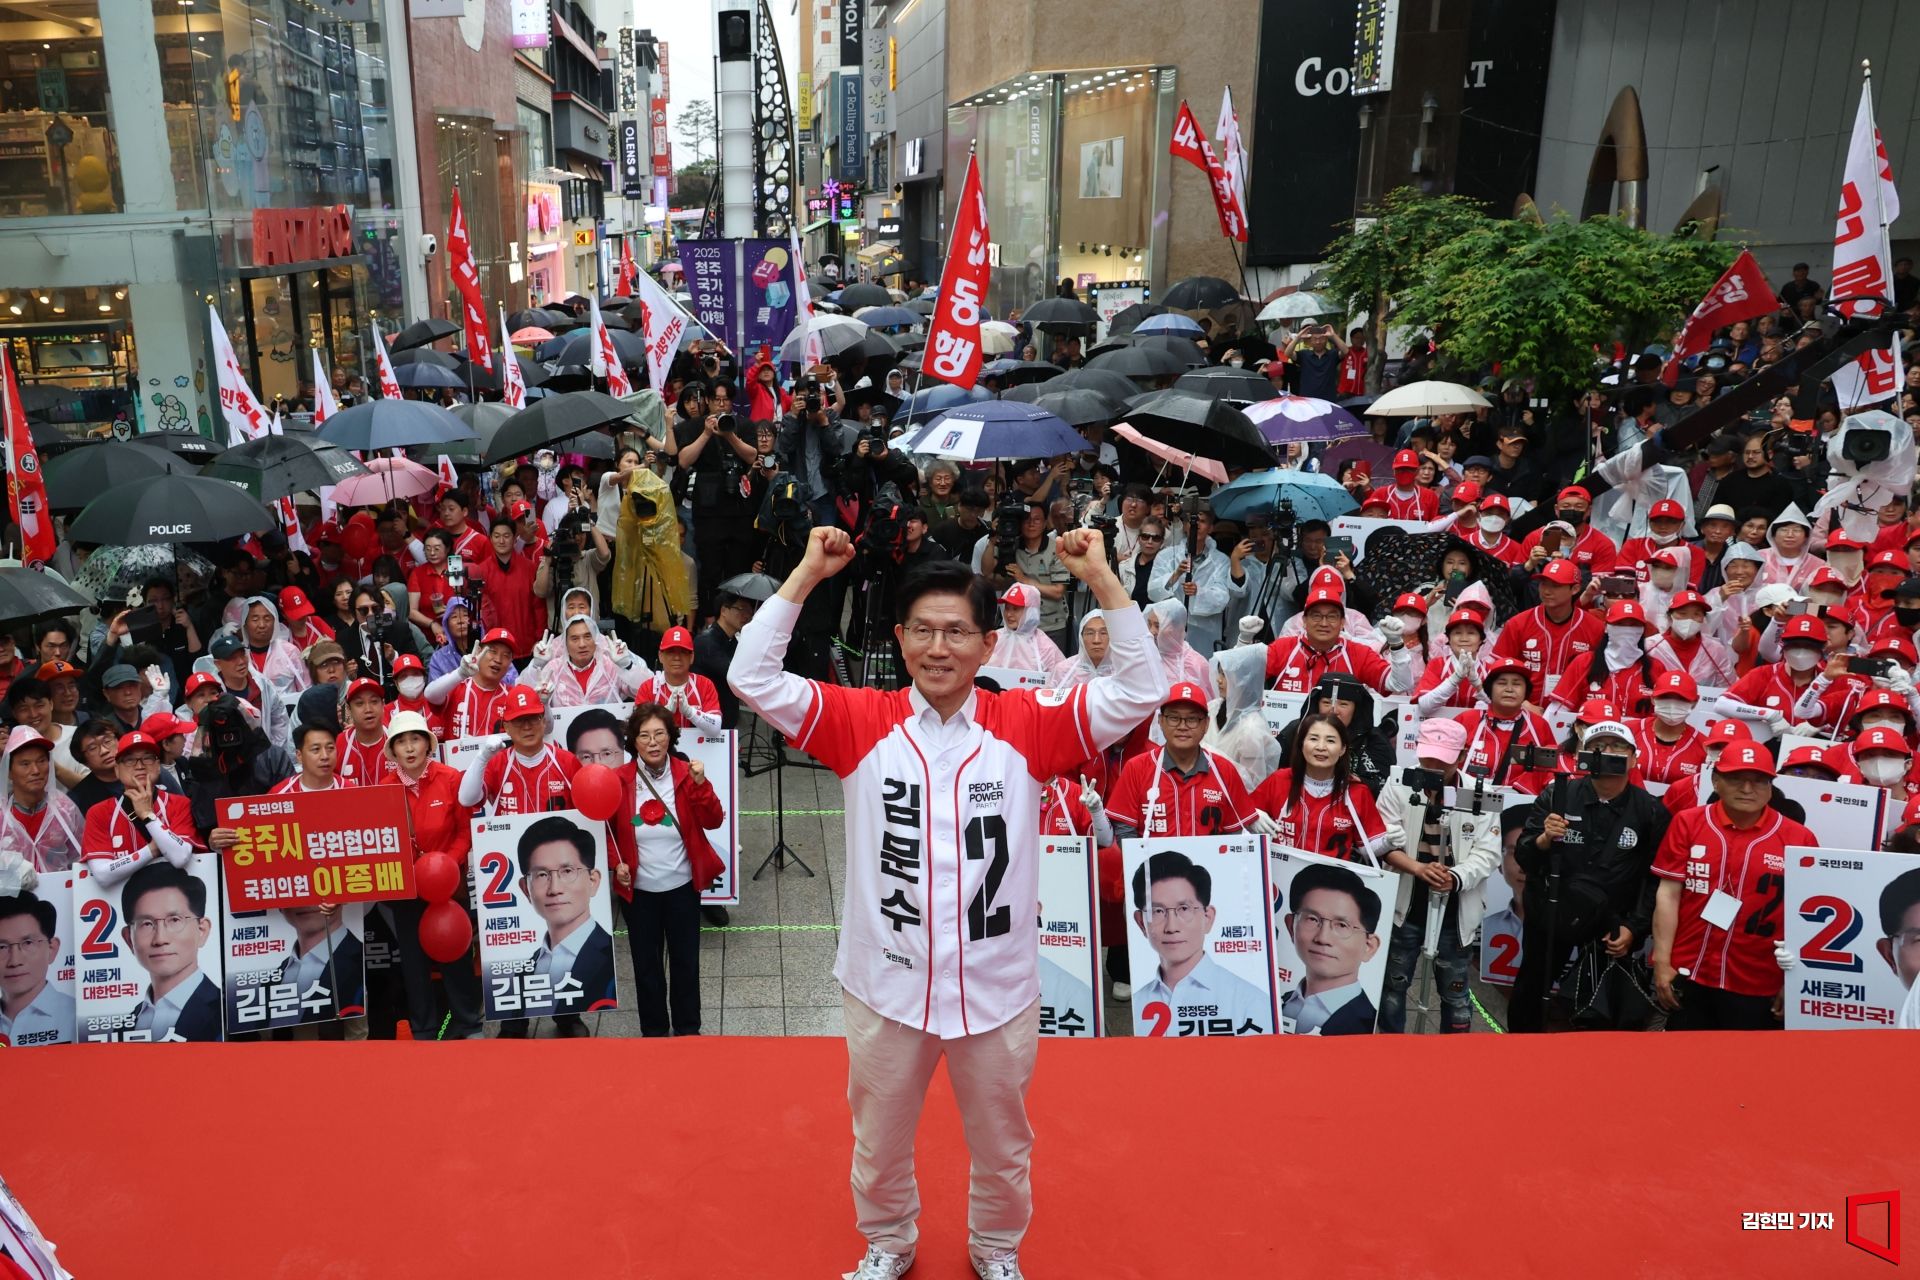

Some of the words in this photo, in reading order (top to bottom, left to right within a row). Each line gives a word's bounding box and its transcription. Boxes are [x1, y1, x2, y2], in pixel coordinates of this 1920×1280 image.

[524, 35, 538, 46] 3F
[1464, 60, 1493, 88] T
[845, 97, 857, 132] Rolling
[625, 126, 636, 166] OLENS
[847, 135, 857, 163] Pasta
[694, 248, 721, 258] 2025
[695, 261, 722, 276] 청주
[754, 263, 774, 278] 신
[697, 277, 723, 292] 국가
[699, 294, 724, 309] 유산
[700, 311, 725, 326] 야행
[1402, 454, 1409, 462] 2
[334, 461, 358, 474] POLICE
[1661, 503, 1669, 511] 2
[149, 524, 192, 535] POLICE
[1884, 552, 1893, 561] 2
[1550, 563, 1560, 573] 2
[1324, 573, 1332, 582] 2
[1010, 588, 1018, 597] 2
[1319, 590, 1327, 599] 2
[1688, 592, 1696, 601] 2
[293, 595, 301, 605] 2
[1407, 596, 1415, 605] 2
[1624, 603, 1633, 613] 2
[1461, 612, 1469, 620] 2
[1800, 620, 1810, 632] 2
[673, 631, 681, 641] 2
[1889, 639, 1900, 649] 2
[403, 656, 410, 666] 2
[1522, 651, 1541, 661] 국민
[155, 677, 165, 686] 2
[197, 673, 204, 682] 2
[1671, 675, 1681, 686] 2
[1282, 679, 1302, 692] 국민
[1182, 687, 1192, 699] 2
[1879, 694, 1890, 704] 2
[517, 694, 526, 706] 2
[1604, 705, 1613, 717] 2
[1724, 724, 1735, 735] 2
[133, 734, 141, 743] 2
[1872, 731, 1884, 744] 2
[1742, 749, 1755, 762] 2
[1811, 750, 1822, 761] 2
[968, 781, 1004, 793] PEOPLE
[1203, 788, 1222, 796] PEOPLE
[500, 796, 518, 809] 국민
[969, 791, 1004, 803] POWER
[1834, 796, 1868, 808] 국민의힘
[248, 801, 294, 816] 국민의힘
[487, 823, 512, 832] 국민의힘
[232, 822, 304, 867] 충주시
[306, 826, 401, 860] 당원협의회
[880, 777, 921, 933] 김문수
[1270, 852, 1289, 862] 민의힘
[1686, 861, 1710, 877] 국민
[1818, 859, 1864, 871] 국민의힘
[244, 874, 310, 900] 국회의원
[313, 861, 404, 897] 이종배
[479, 851, 518, 910] 2
[964, 814, 1011, 942] 2
[1685, 878, 1709, 894] 의힘
[80, 898, 119, 960] 2
[485, 916, 520, 931] 새롭게
[1046, 921, 1079, 934] 새롭게
[231, 925, 269, 941] 새롭게
[486, 930, 537, 946] 대한민국!
[1798, 894, 1864, 974] 2
[1039, 934, 1086, 947] 대한민국!
[1214, 940, 1262, 953] 대한민국!
[231, 940, 286, 957] 대한민국!
[1488, 933, 1520, 977] 2
[490, 959, 536, 975] 정정당당
[83, 967, 121, 983] 새롭게
[235, 969, 283, 987] 정정당당
[83, 983, 139, 1000] 대한민국!
[491, 971, 585, 1012] 김문수
[1801, 980, 1866, 1002] 새롭게
[236, 980, 332, 1024] 김문수
[1177, 1004, 1219, 1018] 정정당당
[1800, 999, 1895, 1025] 대한민국!
[87, 1014, 137, 1031] 정정당당
[1040, 1006, 1086, 1036] 문수
[17, 1030, 59, 1045] 정정당당
